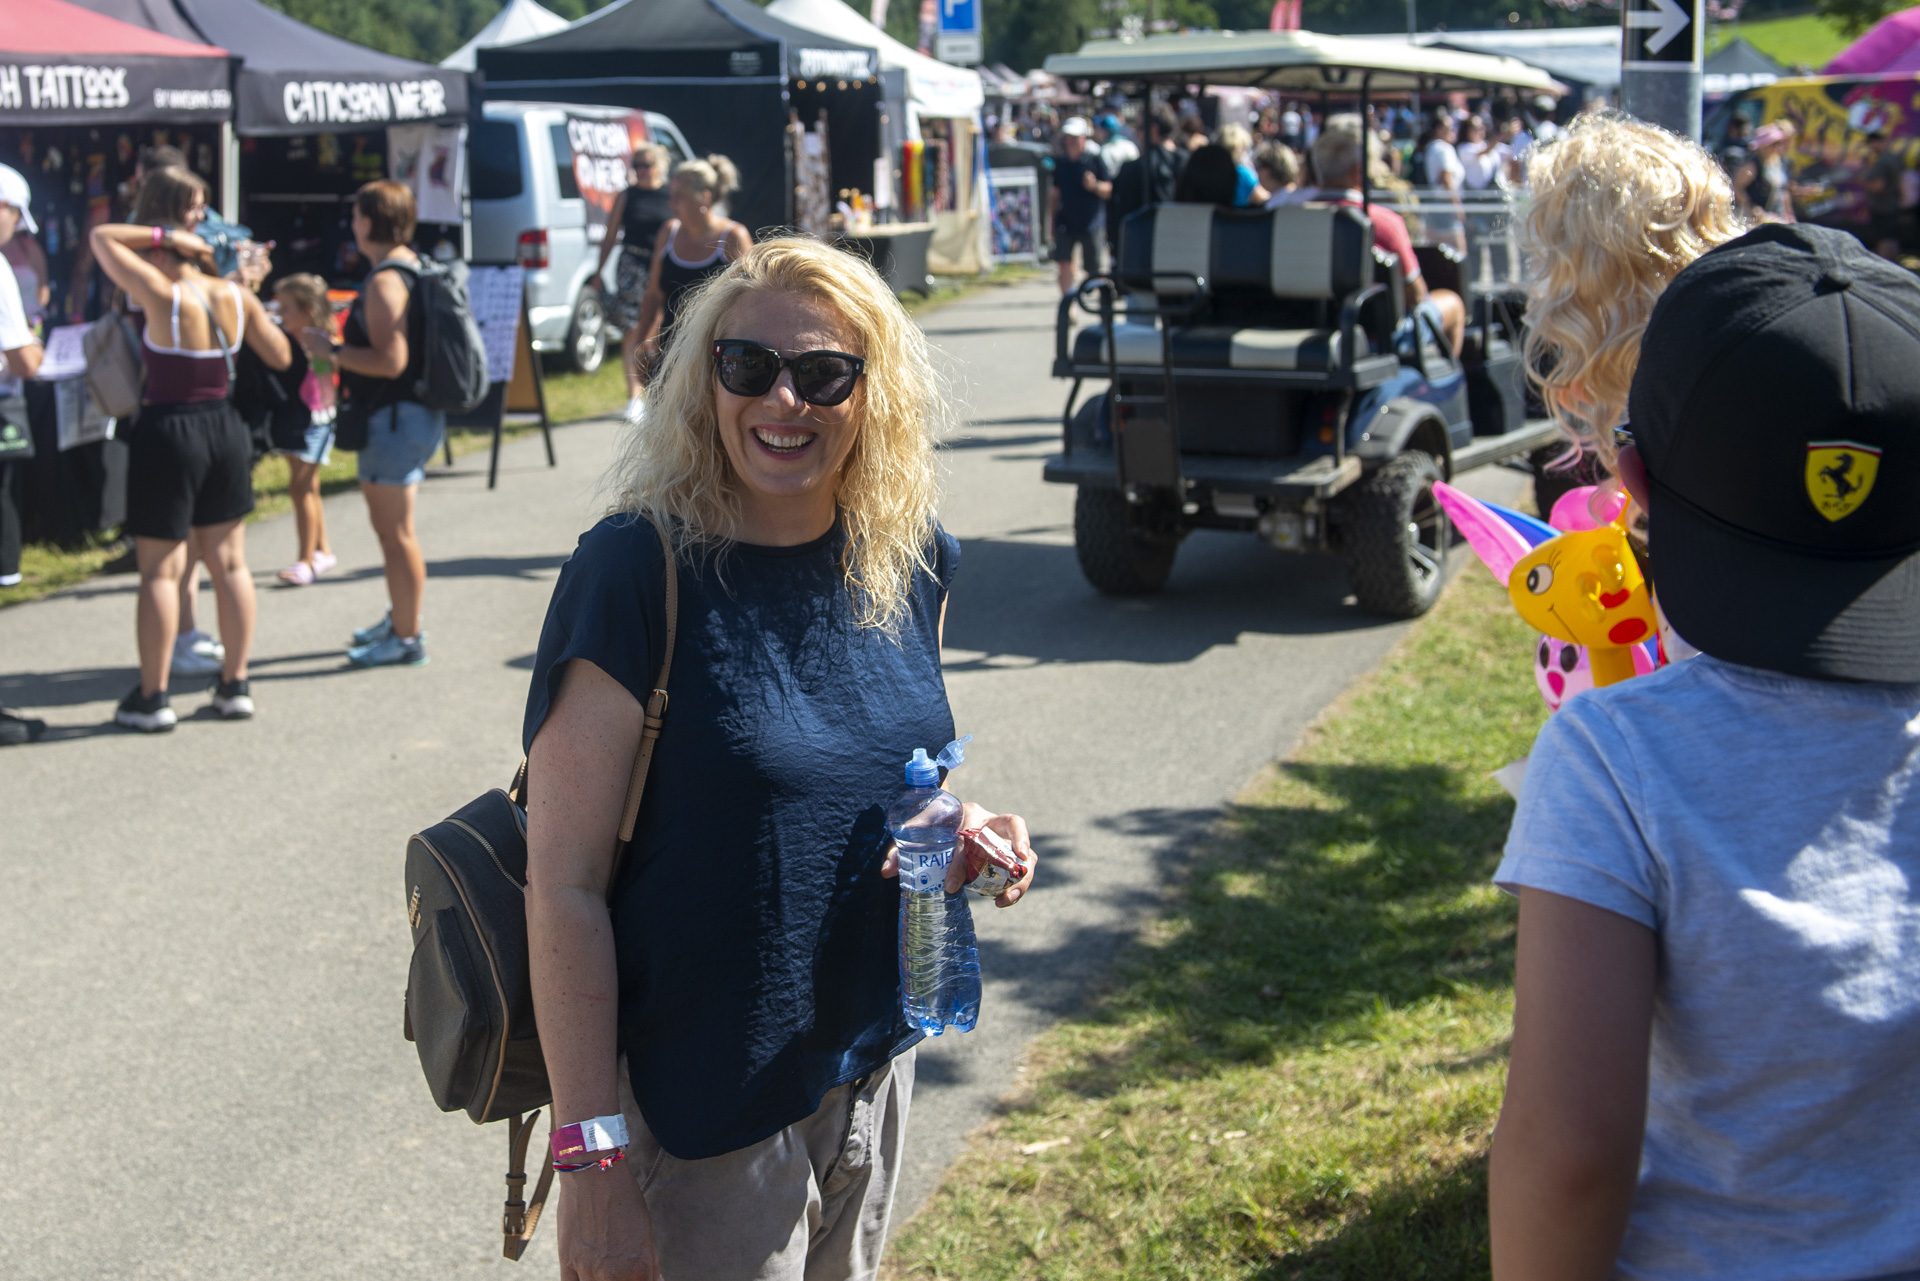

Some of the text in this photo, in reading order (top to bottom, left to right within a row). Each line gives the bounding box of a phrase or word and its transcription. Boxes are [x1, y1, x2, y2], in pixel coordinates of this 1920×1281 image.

[0, 65, 129, 109] H TATTOOS
[283, 81, 391, 123] CATICORN
[918, 850, 954, 870] RAJE
